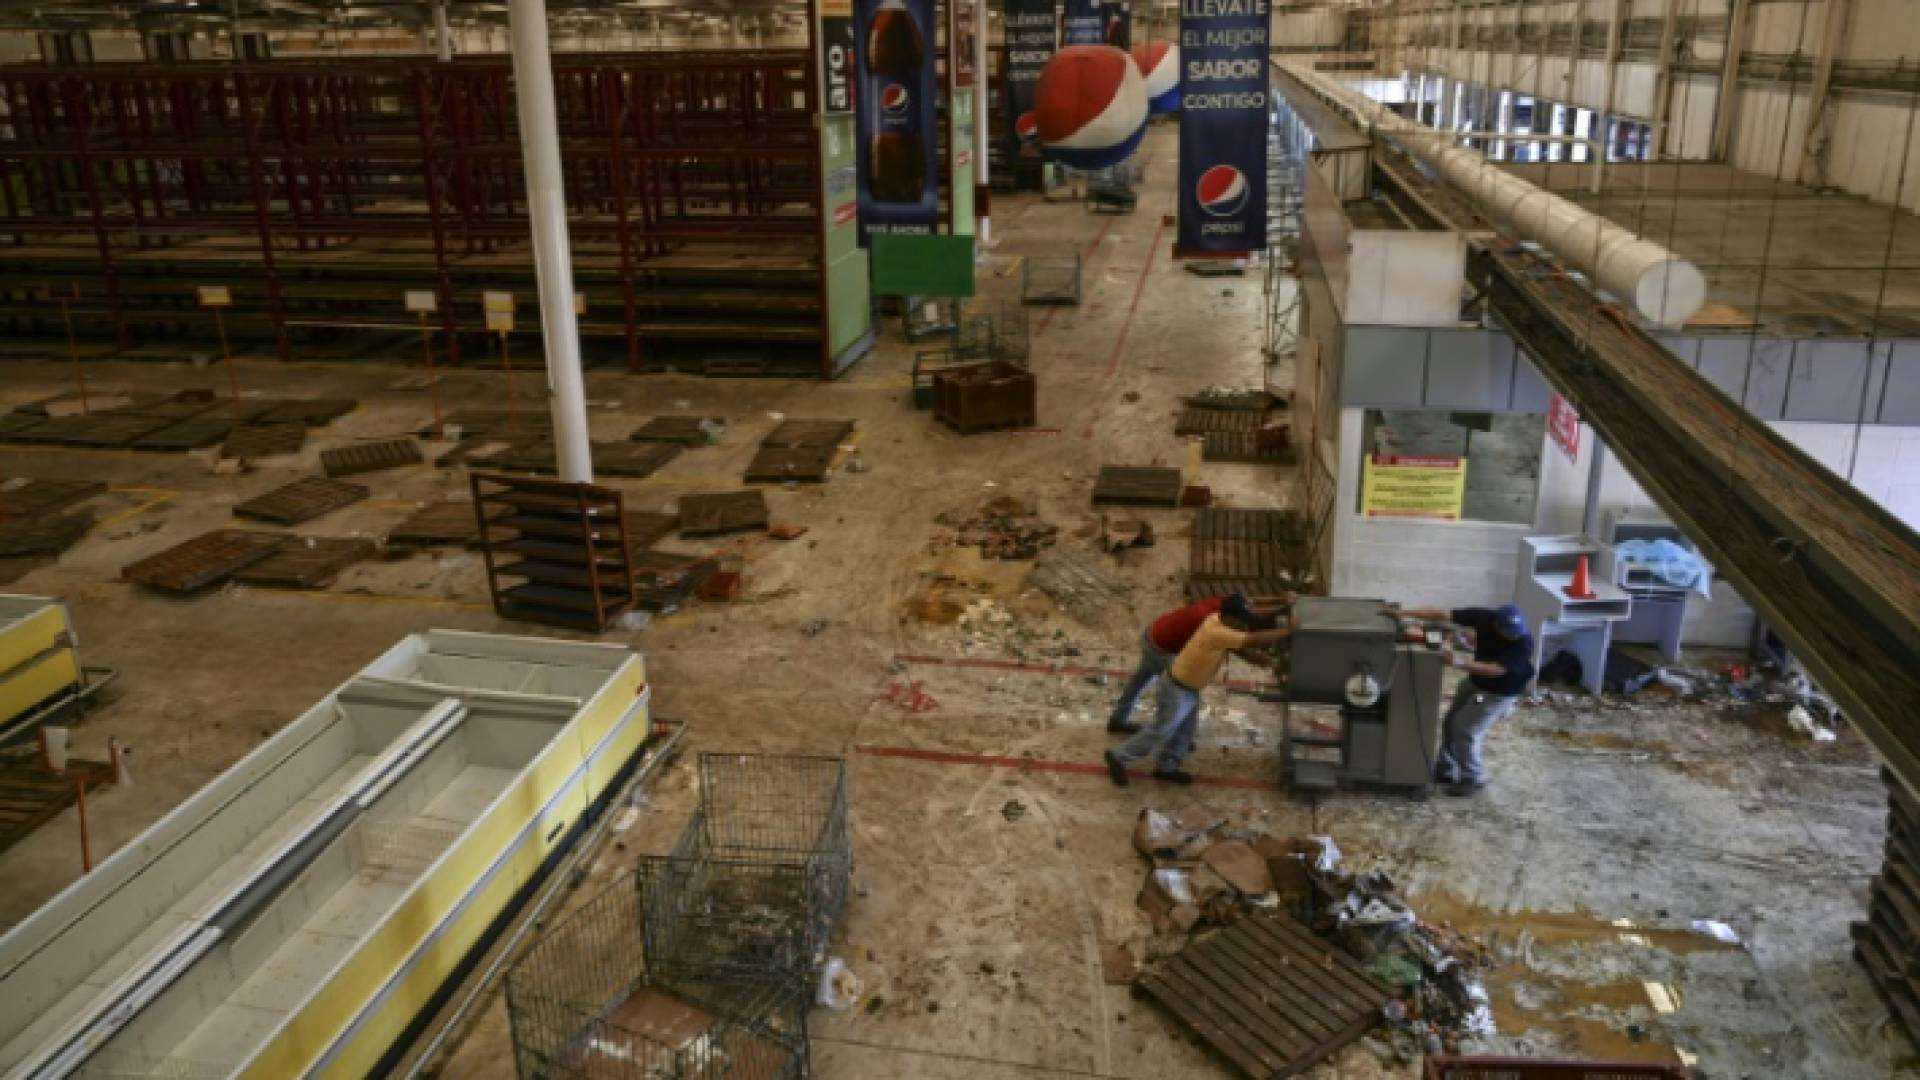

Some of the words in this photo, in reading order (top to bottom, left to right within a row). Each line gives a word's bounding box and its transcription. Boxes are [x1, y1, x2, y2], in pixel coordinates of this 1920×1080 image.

[1183, 30, 1204, 47] EL
[1206, 27, 1264, 51] MEJOR
[829, 45, 846, 108] aro
[1188, 59, 1260, 81] SABOR
[1183, 91, 1264, 110] CONTIGO
